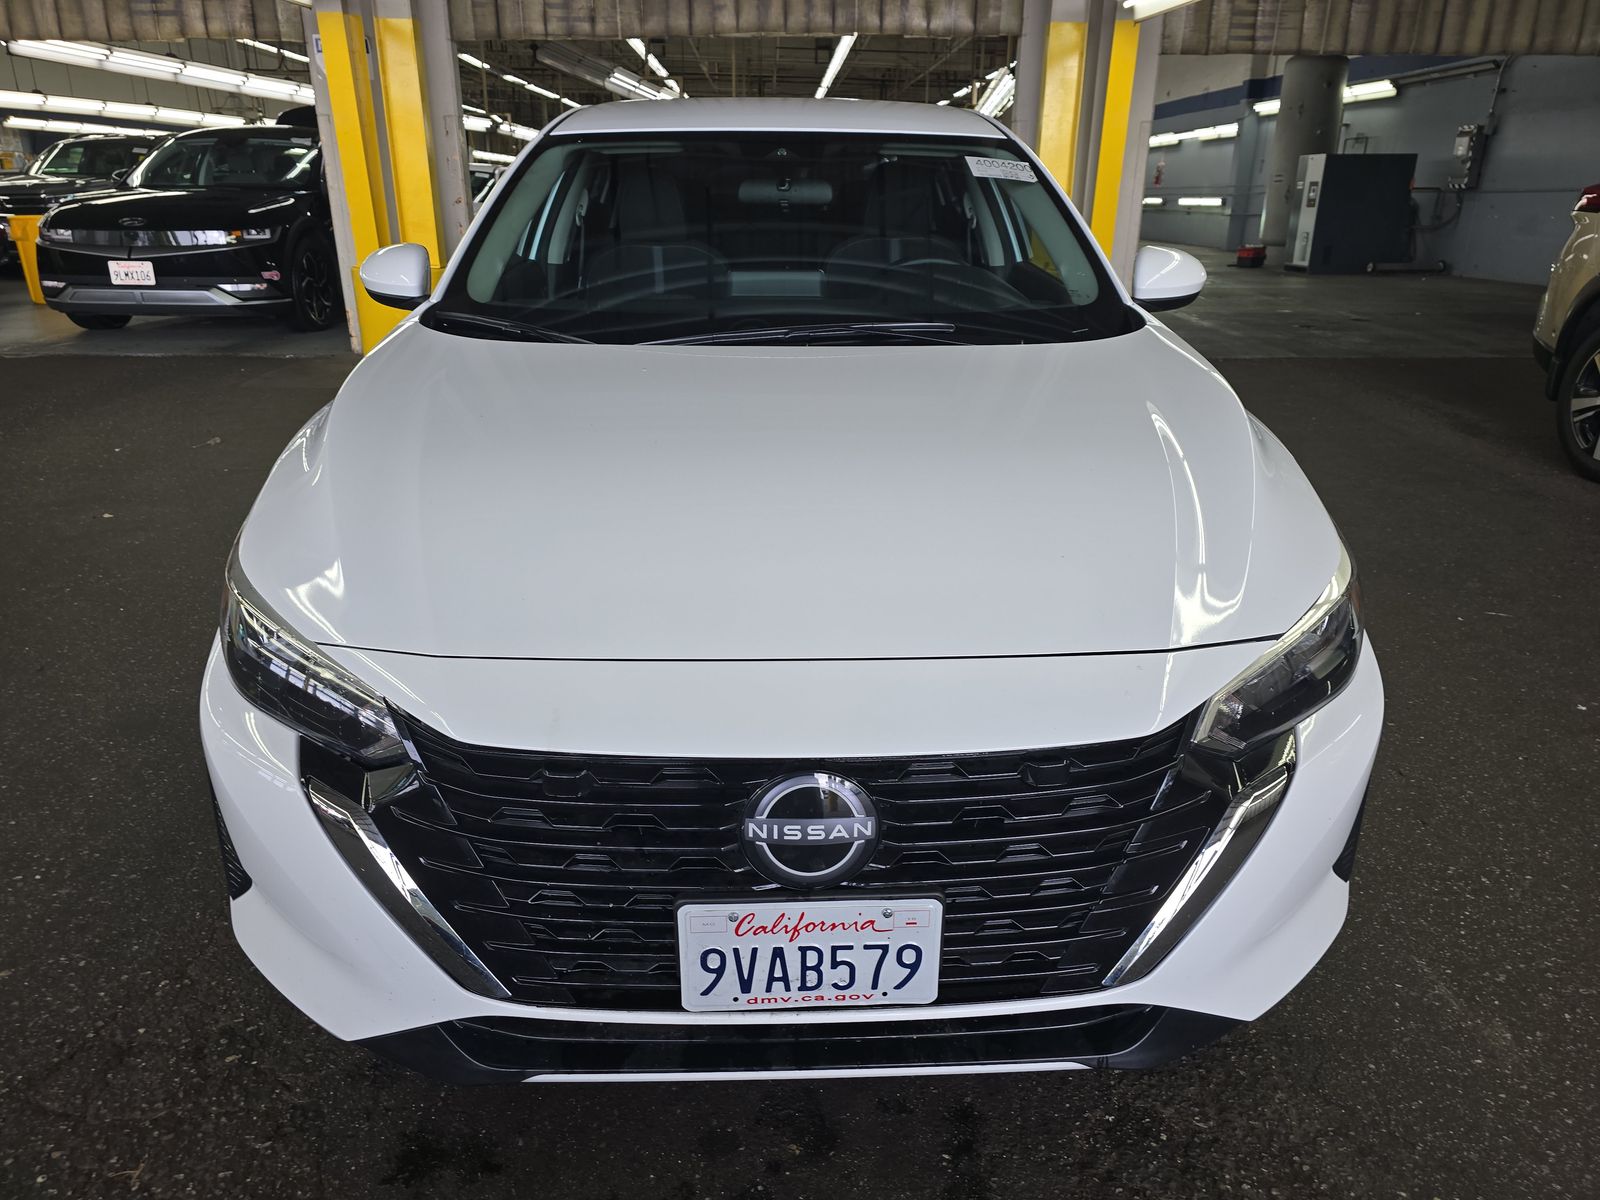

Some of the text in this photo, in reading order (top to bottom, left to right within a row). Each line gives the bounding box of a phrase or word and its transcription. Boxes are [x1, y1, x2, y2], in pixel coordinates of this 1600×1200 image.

[113, 270, 151, 280] 9LMX106
[748, 821, 872, 840] NISSAN
[734, 912, 893, 942] California
[700, 944, 922, 996] 9VAB579
[747, 993, 874, 1004] dmv.ca.gov
